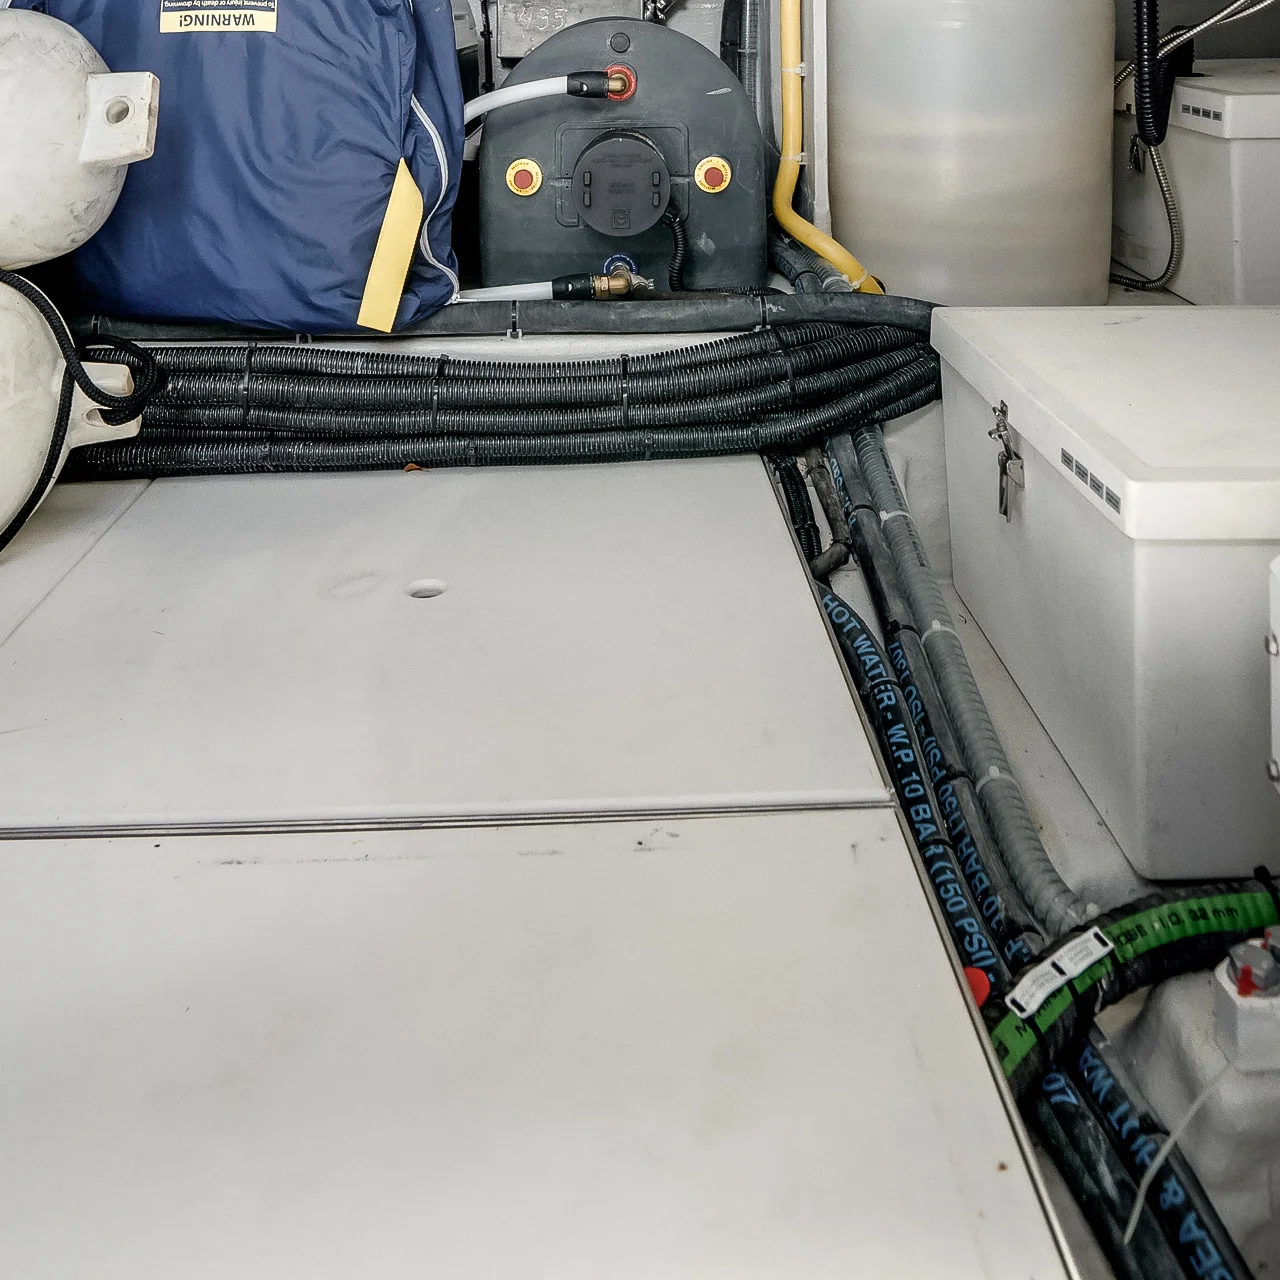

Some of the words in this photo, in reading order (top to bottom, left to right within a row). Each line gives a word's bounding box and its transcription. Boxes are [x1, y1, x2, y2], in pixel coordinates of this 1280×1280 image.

[179, 13, 256, 27] WARNING!
[242, 0, 268, 8] prevent
[822, 593, 860, 632] HOT
[852, 634, 896, 710] WATER
[886, 720, 915, 770] W.P.
[901, 776, 924, 796] 10
[909, 803, 945, 858] BAR
[930, 858, 967, 916] (150
[955, 840, 993, 898] BAR
[1212, 905, 1240, 920] mm
[955, 916, 997, 969] PSI)
[1159, 1177, 1185, 1211] &
